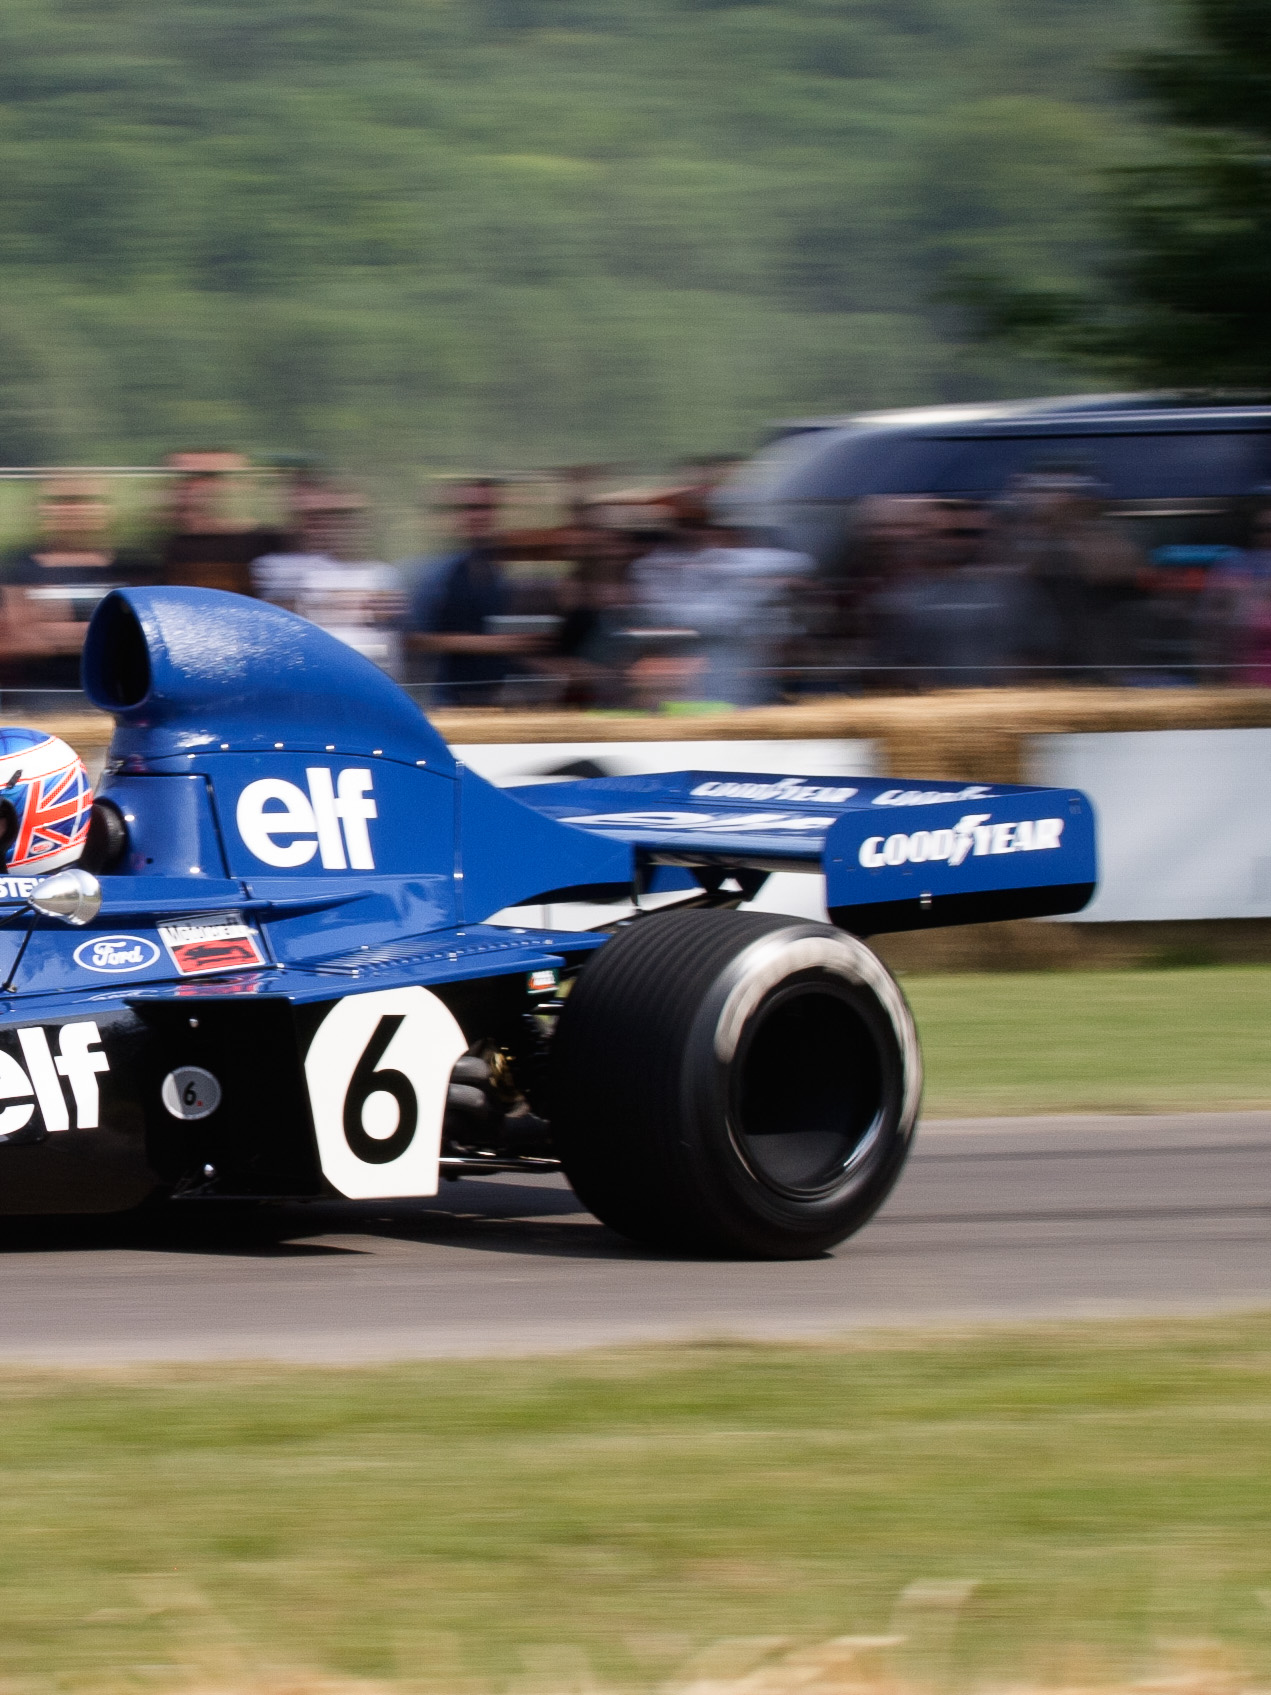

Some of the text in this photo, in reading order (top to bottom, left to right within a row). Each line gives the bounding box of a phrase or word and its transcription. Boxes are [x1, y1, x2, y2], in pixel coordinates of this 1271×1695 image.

[689, 778, 859, 802] GOODYEAR
[236, 767, 377, 870] elf
[858, 813, 1064, 868] GOODYEAR
[92, 940, 143, 967] Ford
[184, 1081, 197, 1106] 6
[343, 1014, 419, 1165] 6
